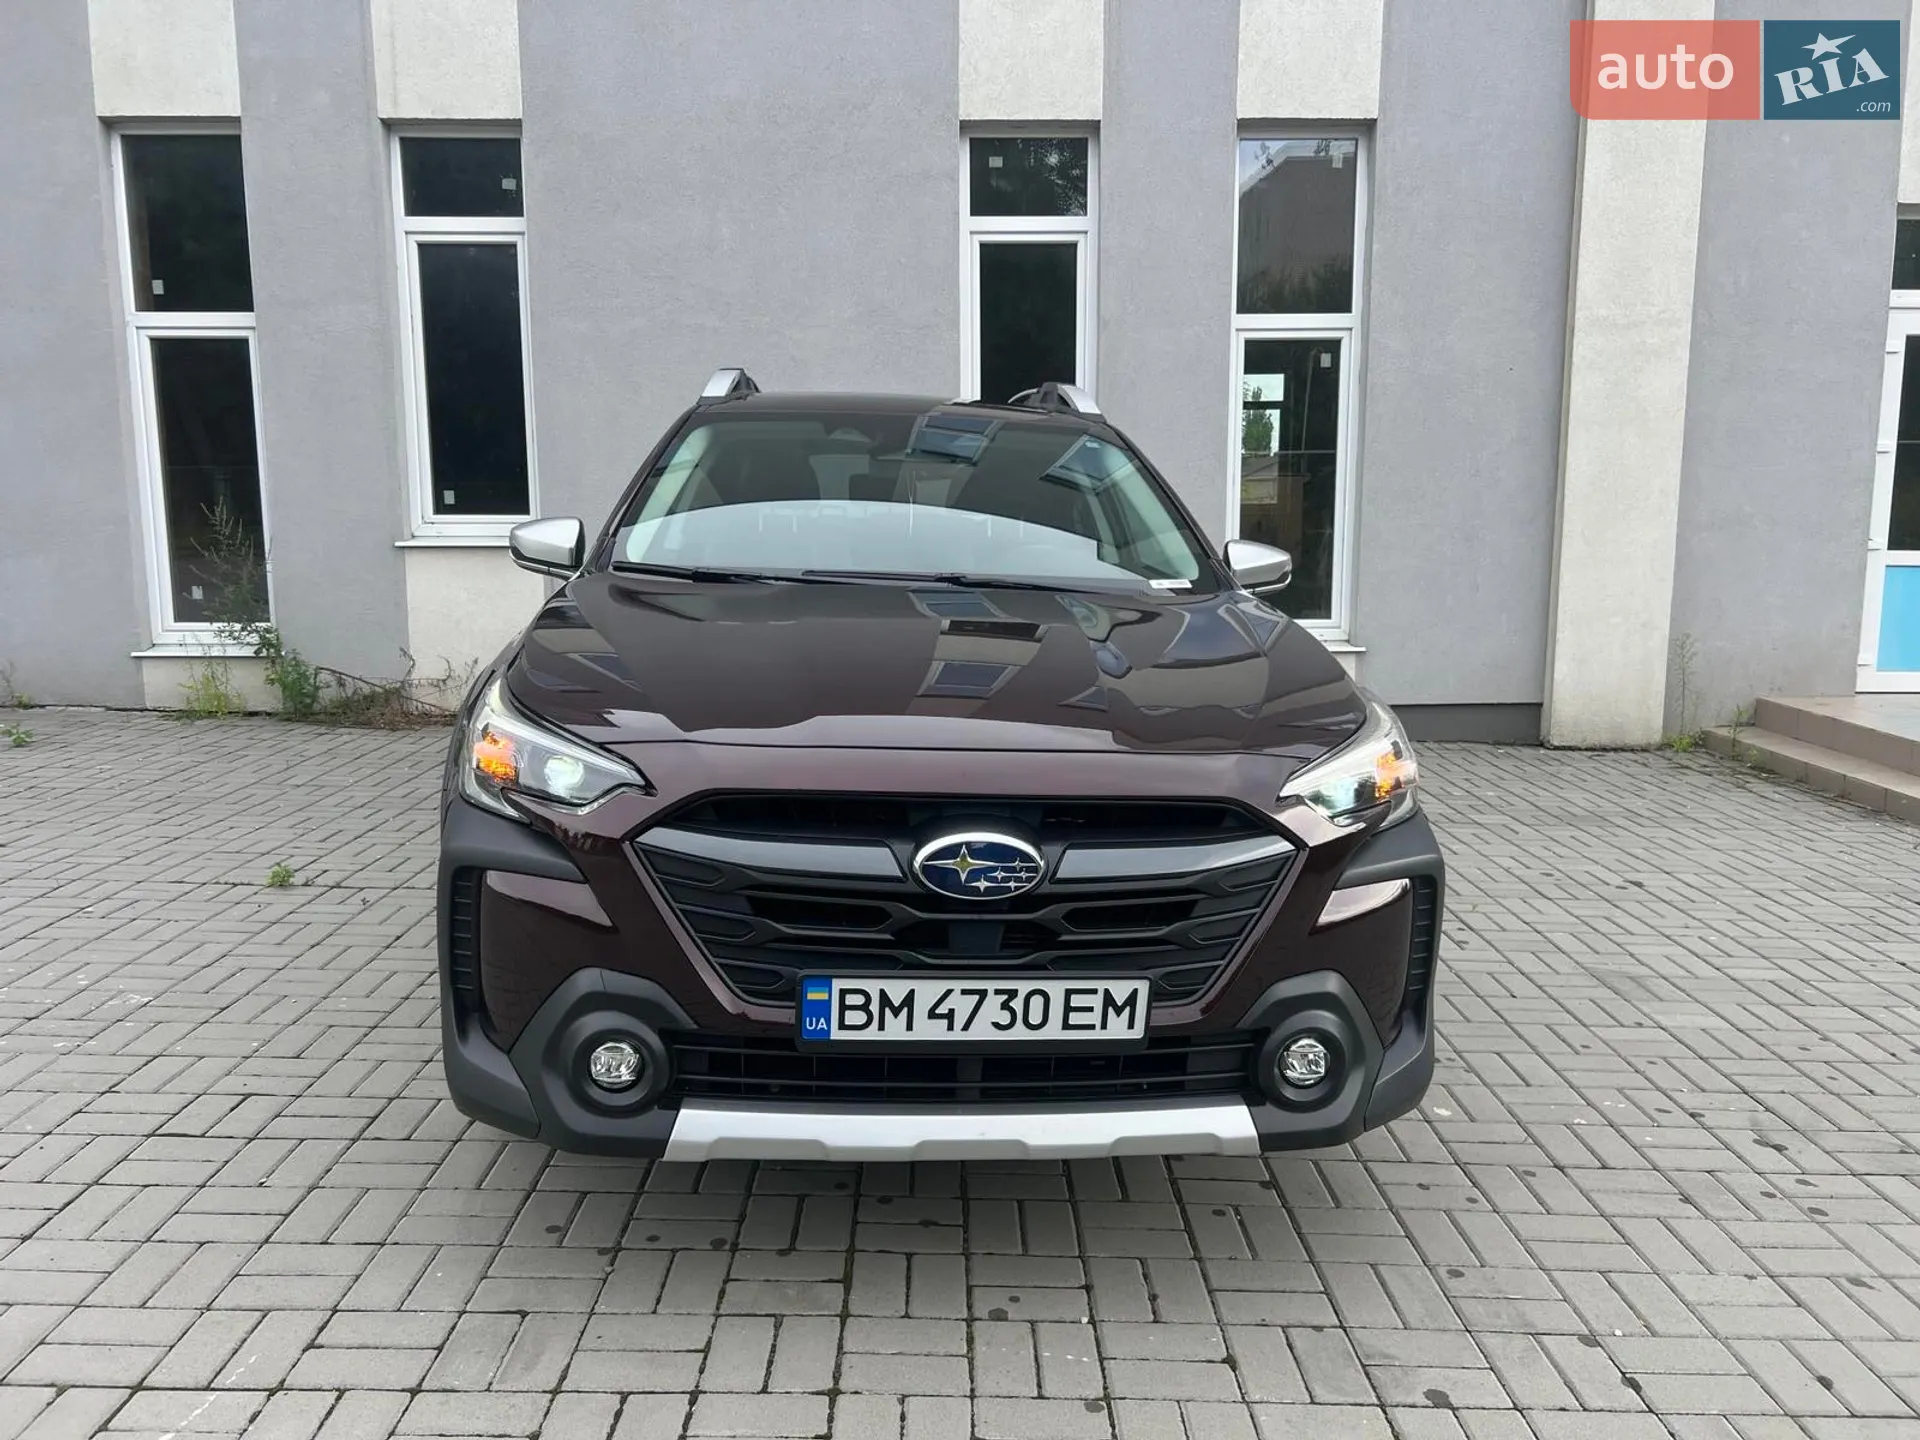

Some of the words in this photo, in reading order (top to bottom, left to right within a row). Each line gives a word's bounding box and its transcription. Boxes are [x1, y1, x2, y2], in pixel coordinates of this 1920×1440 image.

[805, 1017, 828, 1031] UA
[837, 987, 916, 1032] BM
[927, 988, 1051, 1032] 4730
[1061, 987, 1139, 1031] EM
